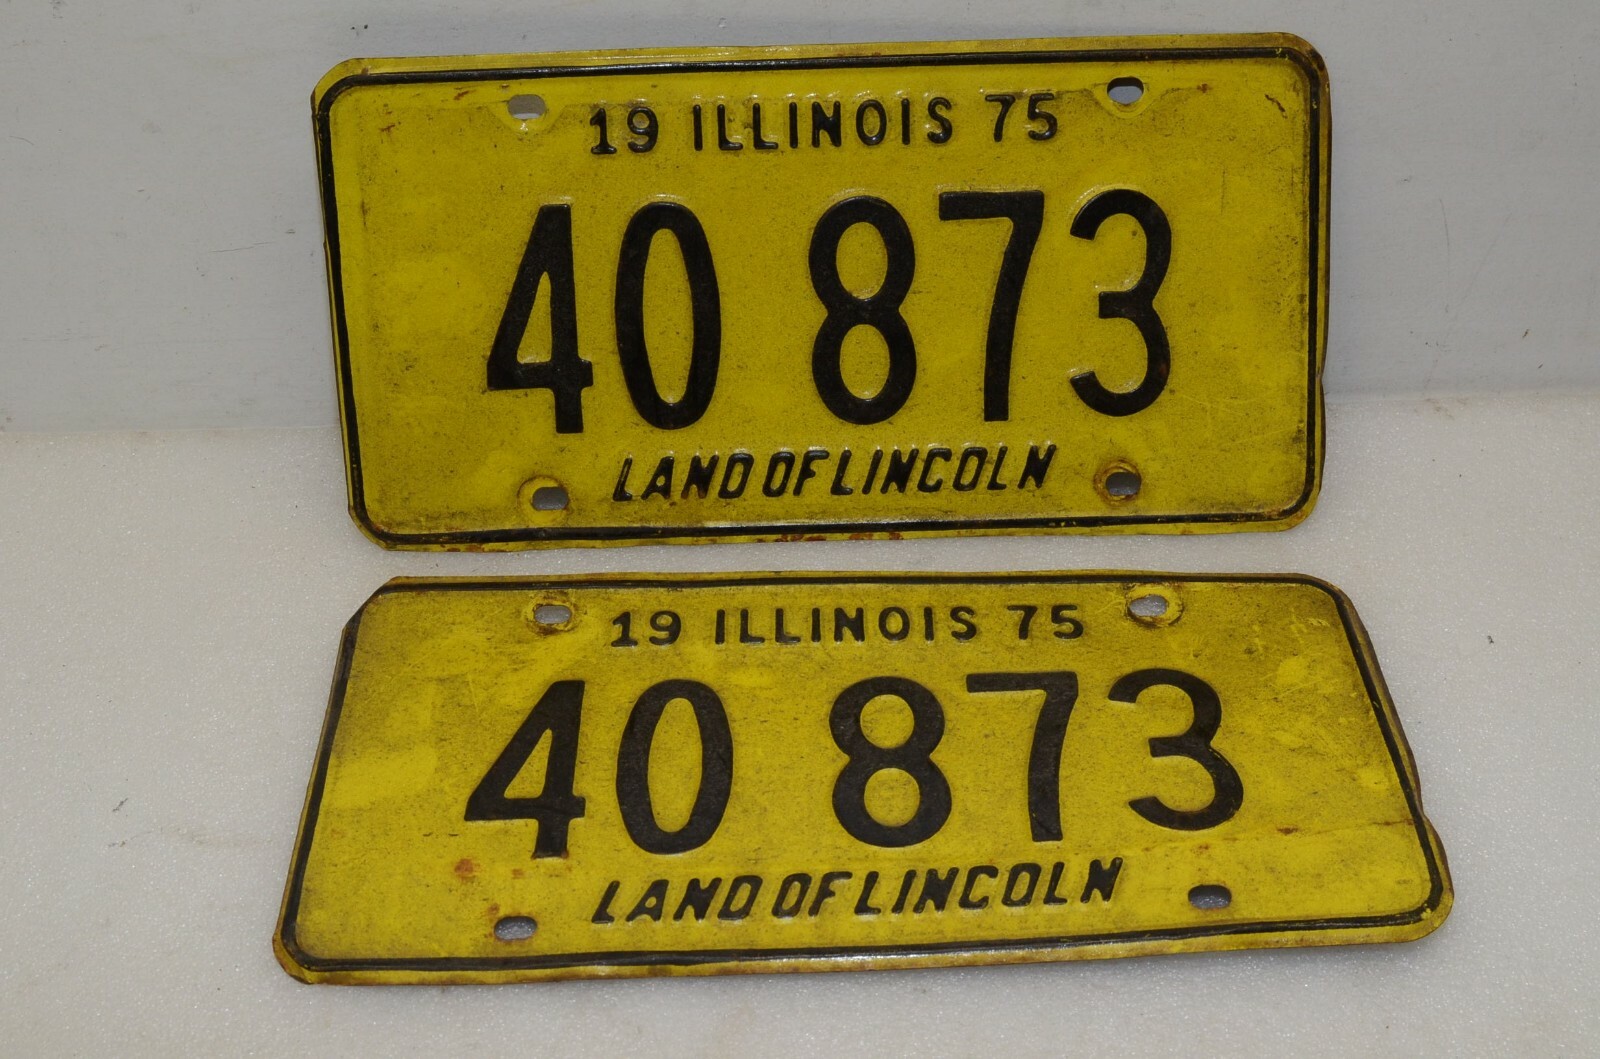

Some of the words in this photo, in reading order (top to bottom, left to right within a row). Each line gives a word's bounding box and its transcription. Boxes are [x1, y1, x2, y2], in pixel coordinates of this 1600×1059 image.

[589, 105, 661, 156] 19
[691, 96, 954, 152] ILLINOIS
[984, 91, 1059, 143] 75
[485, 201, 723, 435] 40
[807, 188, 1174, 426] 873
[610, 451, 755, 503] LAND
[761, 449, 831, 499] OF
[829, 444, 1059, 497] LINCOLN
[610, 609, 683, 648] 19
[714, 604, 979, 645] ILLINOIS
[1005, 603, 1085, 641] 75
[463, 677, 735, 859] 40
[828, 666, 1245, 848] 873
[591, 873, 763, 925] LAND
[771, 870, 853, 919] OF
[853, 856, 1125, 916] LINCOLN
